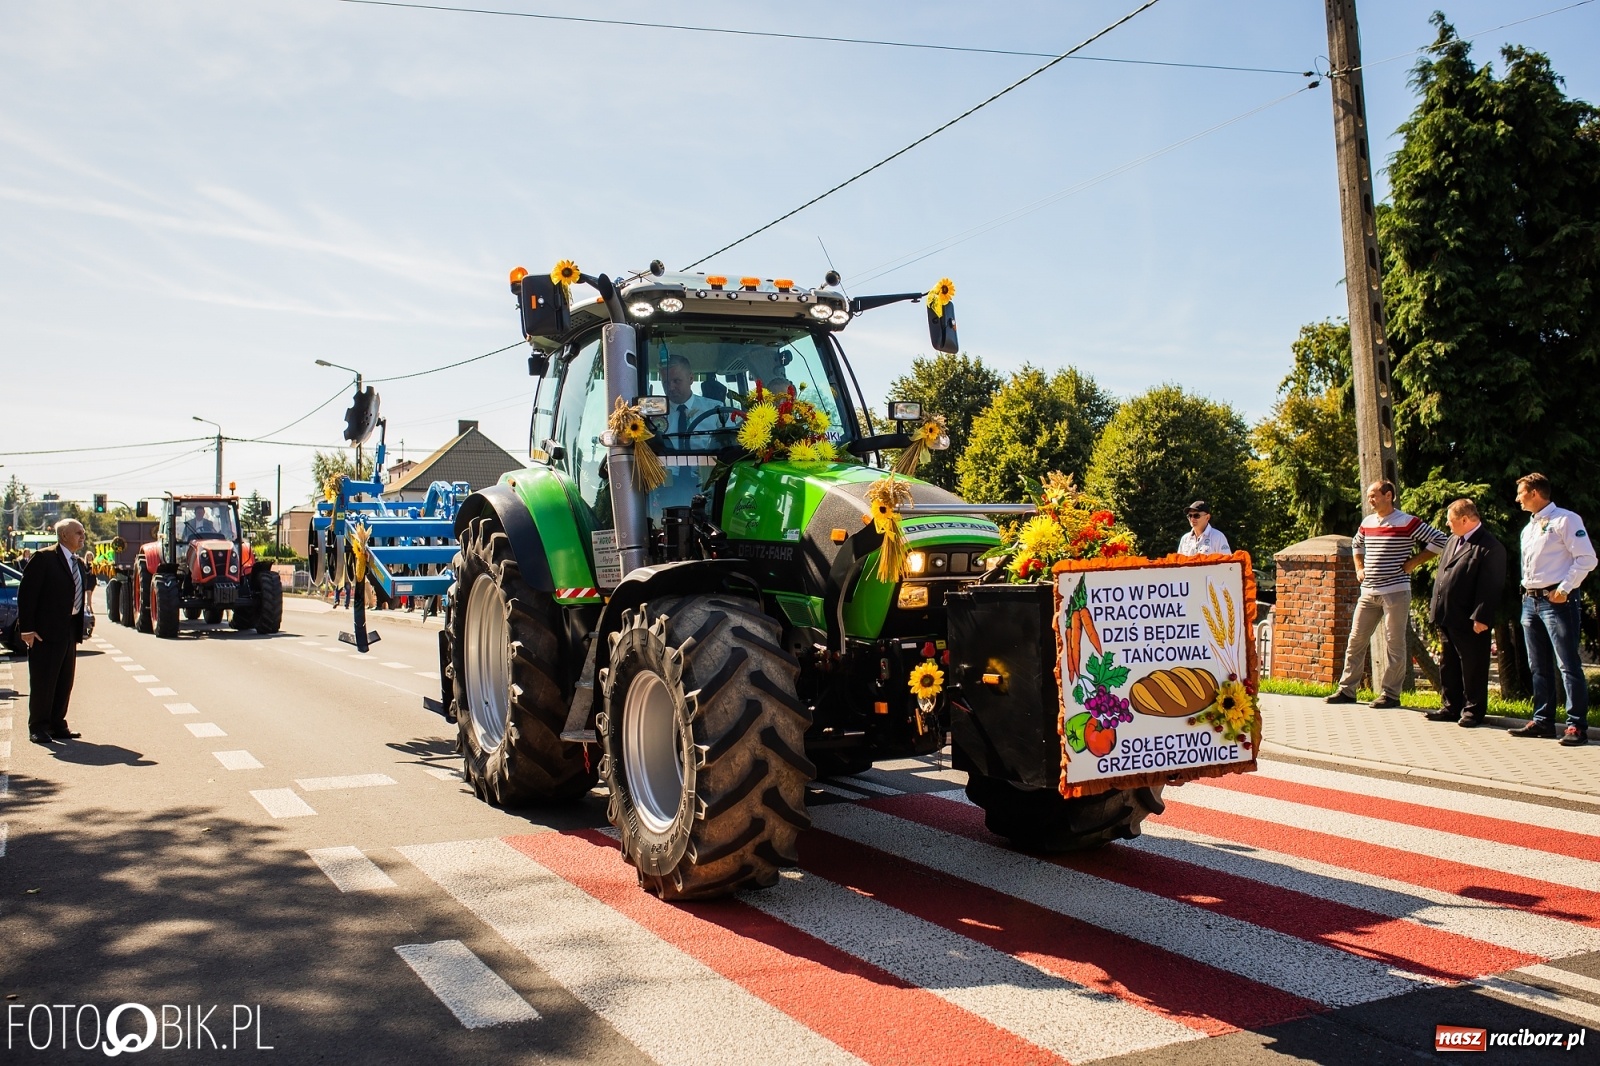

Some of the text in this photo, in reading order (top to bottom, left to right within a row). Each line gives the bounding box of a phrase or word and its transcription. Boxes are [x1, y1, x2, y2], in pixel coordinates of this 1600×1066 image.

[1091, 582, 1189, 604] KTO W POLU
[1093, 602, 1186, 622] PRACOWAŁ
[1102, 623, 1200, 644] DZIŚ BĘDZIE
[1122, 644, 1211, 663] TAŃCOWAŁ
[1121, 731, 1212, 754] SOŁECTWO
[1097, 745, 1239, 773] GRZEGORZOWICE
